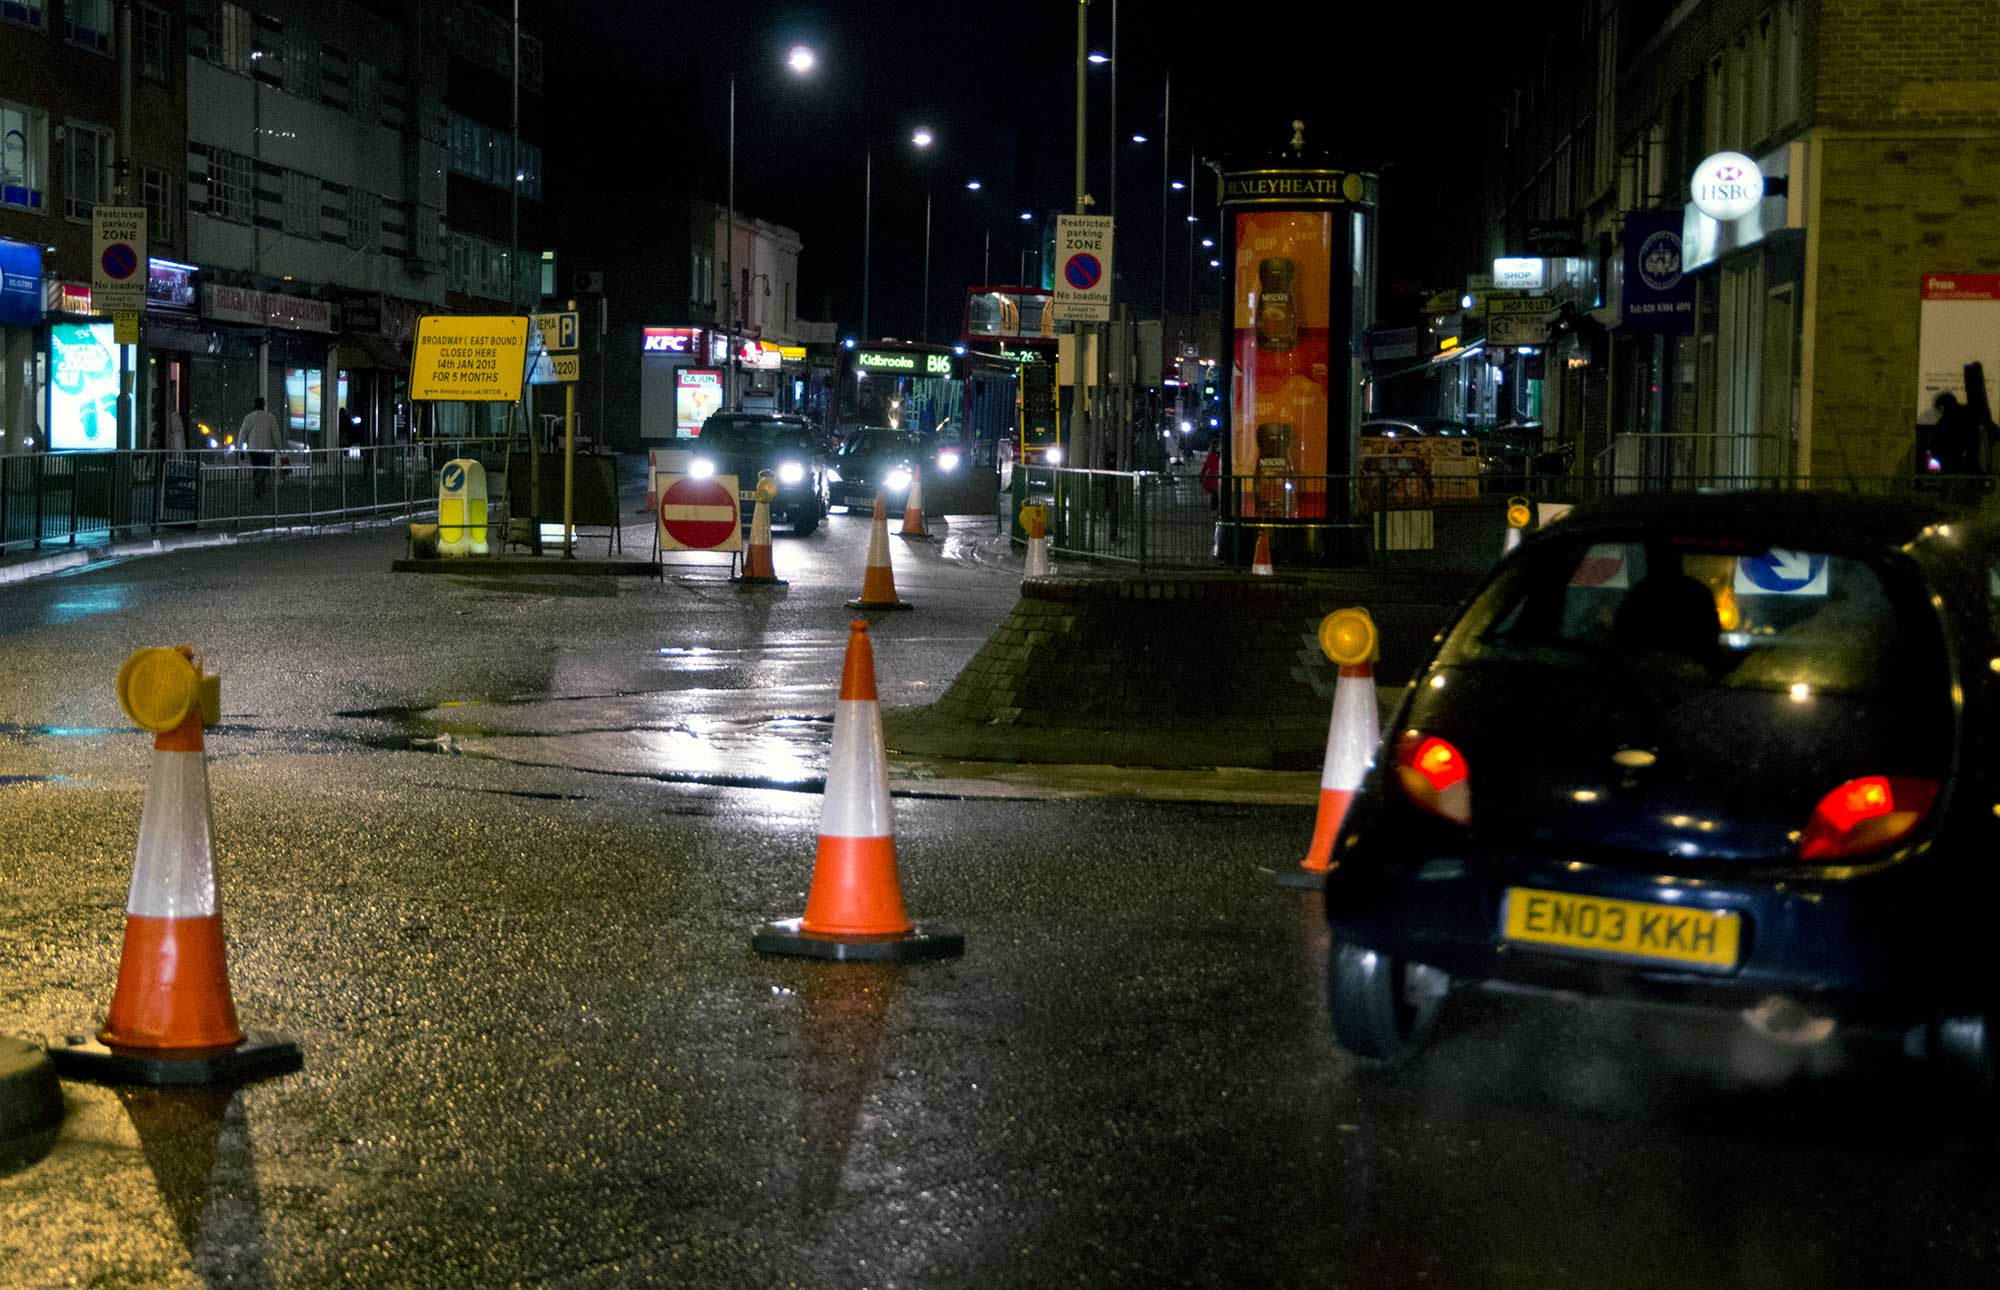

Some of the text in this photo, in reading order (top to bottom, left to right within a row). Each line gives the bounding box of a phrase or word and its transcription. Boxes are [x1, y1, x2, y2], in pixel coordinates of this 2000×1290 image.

[1702, 183, 1758, 201] HSBC
[96, 210, 144, 219] Restricted
[102, 221, 137, 230] parking
[1061, 218, 1110, 228] Restricted
[102, 230, 137, 240] ZONE
[1067, 229, 1103, 239] parking
[1066, 239, 1102, 250] ZONE
[1503, 271, 1531, 280] SHOP
[94, 281, 107, 289] No
[111, 281, 144, 292] loading
[1929, 278, 1956, 289] Free
[1056, 291, 1108, 302] No loading
[1502, 299, 1549, 311] SHOP TO LET
[114, 311, 137, 319] CCTV
[421, 335, 464, 345] BROADWAY
[490, 336, 517, 346] BOUND
[644, 335, 688, 351] KFC
[440, 348, 497, 358] CLOSED HERE
[438, 359, 497, 369] 14th JAN 2013
[859, 353, 951, 373] Kidbrooke B16
[432, 372, 499, 382] FOR 5 MONTHS
[683, 375, 716, 383] CAJUN
[1525, 896, 1717, 954] EN03 KKH
